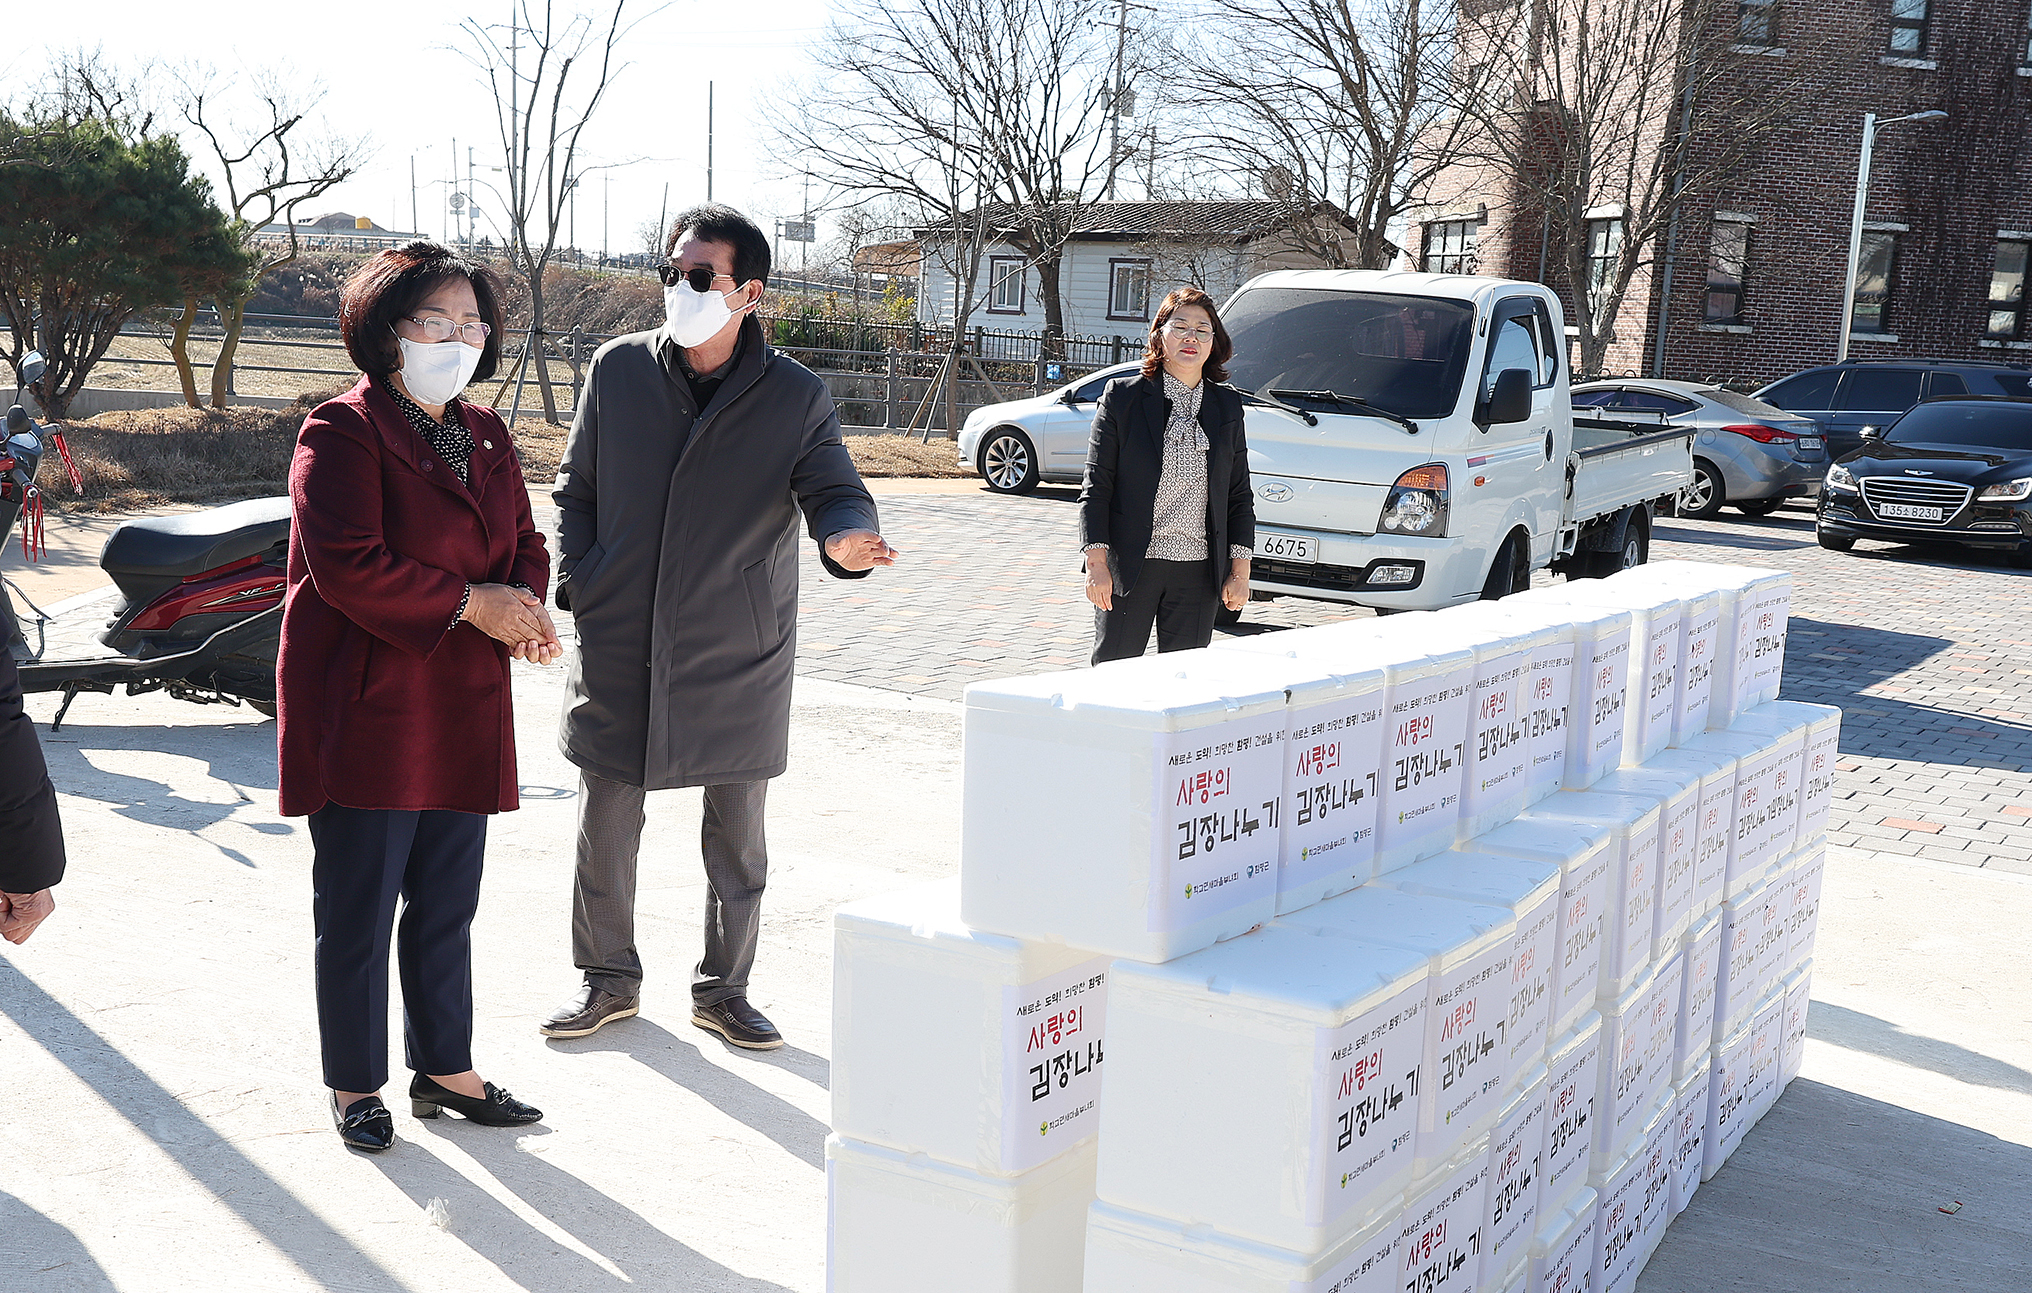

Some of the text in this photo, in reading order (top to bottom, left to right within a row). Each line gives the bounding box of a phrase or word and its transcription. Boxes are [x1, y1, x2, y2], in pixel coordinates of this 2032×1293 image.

[1884, 506, 1938, 518] 135소 8230
[1264, 538, 1306, 557] 6675
[1757, 612, 1774, 630] 사랑의
[1653, 642, 1667, 666] 사랑의
[1690, 638, 1707, 658] 사랑의
[1755, 633, 1787, 658] 김장나누기
[1476, 678, 1489, 688] 새로운
[1534, 677, 1553, 700] 사랑의
[1596, 665, 1614, 690] 사랑의
[1393, 704, 1408, 713] 새로운
[1410, 698, 1422, 709] 도약!
[1438, 690, 1449, 701] 함평!
[1480, 690, 1508, 720] 사랑의
[1595, 686, 1627, 725] 김장나누기
[1292, 727, 1308, 740] 새로운
[1311, 722, 1324, 736] 도약!
[1328, 718, 1343, 731] 희망찬
[1346, 714, 1358, 727] 함평!
[1361, 711, 1376, 724] 건설을
[1396, 715, 1434, 746] 사랑의
[1479, 714, 1530, 761] 김장나누기
[1532, 705, 1569, 738] 김장나누기
[1168, 751, 1192, 766] 새로운
[1196, 746, 1212, 760] 도약!
[1215, 741, 1234, 756] 희망찬
[1236, 736, 1252, 751] 함평!
[1255, 732, 1273, 747] 건설을
[1296, 742, 1340, 776] 사랑의
[1810, 753, 1826, 772] 사랑의
[1395, 740, 1465, 792] 김장나누기
[1176, 767, 1230, 806] 사랑의
[1297, 769, 1380, 826] 김장나누기
[1740, 786, 1759, 809] 사랑의
[1807, 772, 1835, 800] 김장나누기
[1178, 796, 1280, 860] 김장나누기
[1703, 807, 1719, 831] 사랑의
[1669, 827, 1684, 855] 사랑의
[1629, 861, 1644, 889] 사랑의
[1567, 894, 1589, 928] 사랑의
[1792, 884, 1809, 907] 사랑의
[1565, 911, 1604, 968] 김장나누기
[1731, 927, 1748, 951] 사랑의
[1512, 945, 1536, 984] 사랑의
[1694, 959, 1708, 984] 사랑의
[1017, 973, 1105, 1016] 새로운 도약! 희망찬 함평!
[1436, 989, 1453, 1006] 새로운
[1441, 997, 1476, 1042] 사랑의
[1651, 996, 1668, 1027] 사랑의
[1787, 1006, 1800, 1031] 사랑의
[1027, 1006, 1082, 1052] 사랑의
[1332, 1044, 1352, 1060] 새로운
[1355, 1033, 1369, 1050] 도약!
[1371, 1024, 1387, 1040] 희망찬
[1388, 1013, 1401, 1030] 함평!
[1750, 1032, 1768, 1057] 사랑의
[1442, 1015, 1509, 1090] 김장나누기
[1338, 1048, 1383, 1100] 사랑의
[1618, 1049, 1648, 1101] 김장나누기
[1720, 1069, 1736, 1097] 사랑의
[1338, 1064, 1420, 1152] 김장나누기
[1552, 1082, 1576, 1121] 사랑의
[1550, 1092, 1595, 1159] 김장나누기
[1679, 1112, 1694, 1139] 사랑의
[1496, 1140, 1522, 1184] 사랑의
[1646, 1146, 1662, 1180] 사랑의
[1494, 1151, 1542, 1226] 김장나누기
[1402, 1220, 1420, 1238] 새로운
[1422, 1208, 1434, 1226] 도약!
[1436, 1196, 1450, 1214] 희망찬
[1452, 1185, 1464, 1203] 함평!
[1605, 1200, 1626, 1235] 사랑의
[1406, 1219, 1447, 1270] 사랑의
[1605, 1210, 1642, 1271] 김장나누기
[1344, 1268, 1359, 1288] 희망찬
[1362, 1256, 1374, 1274] 함평!
